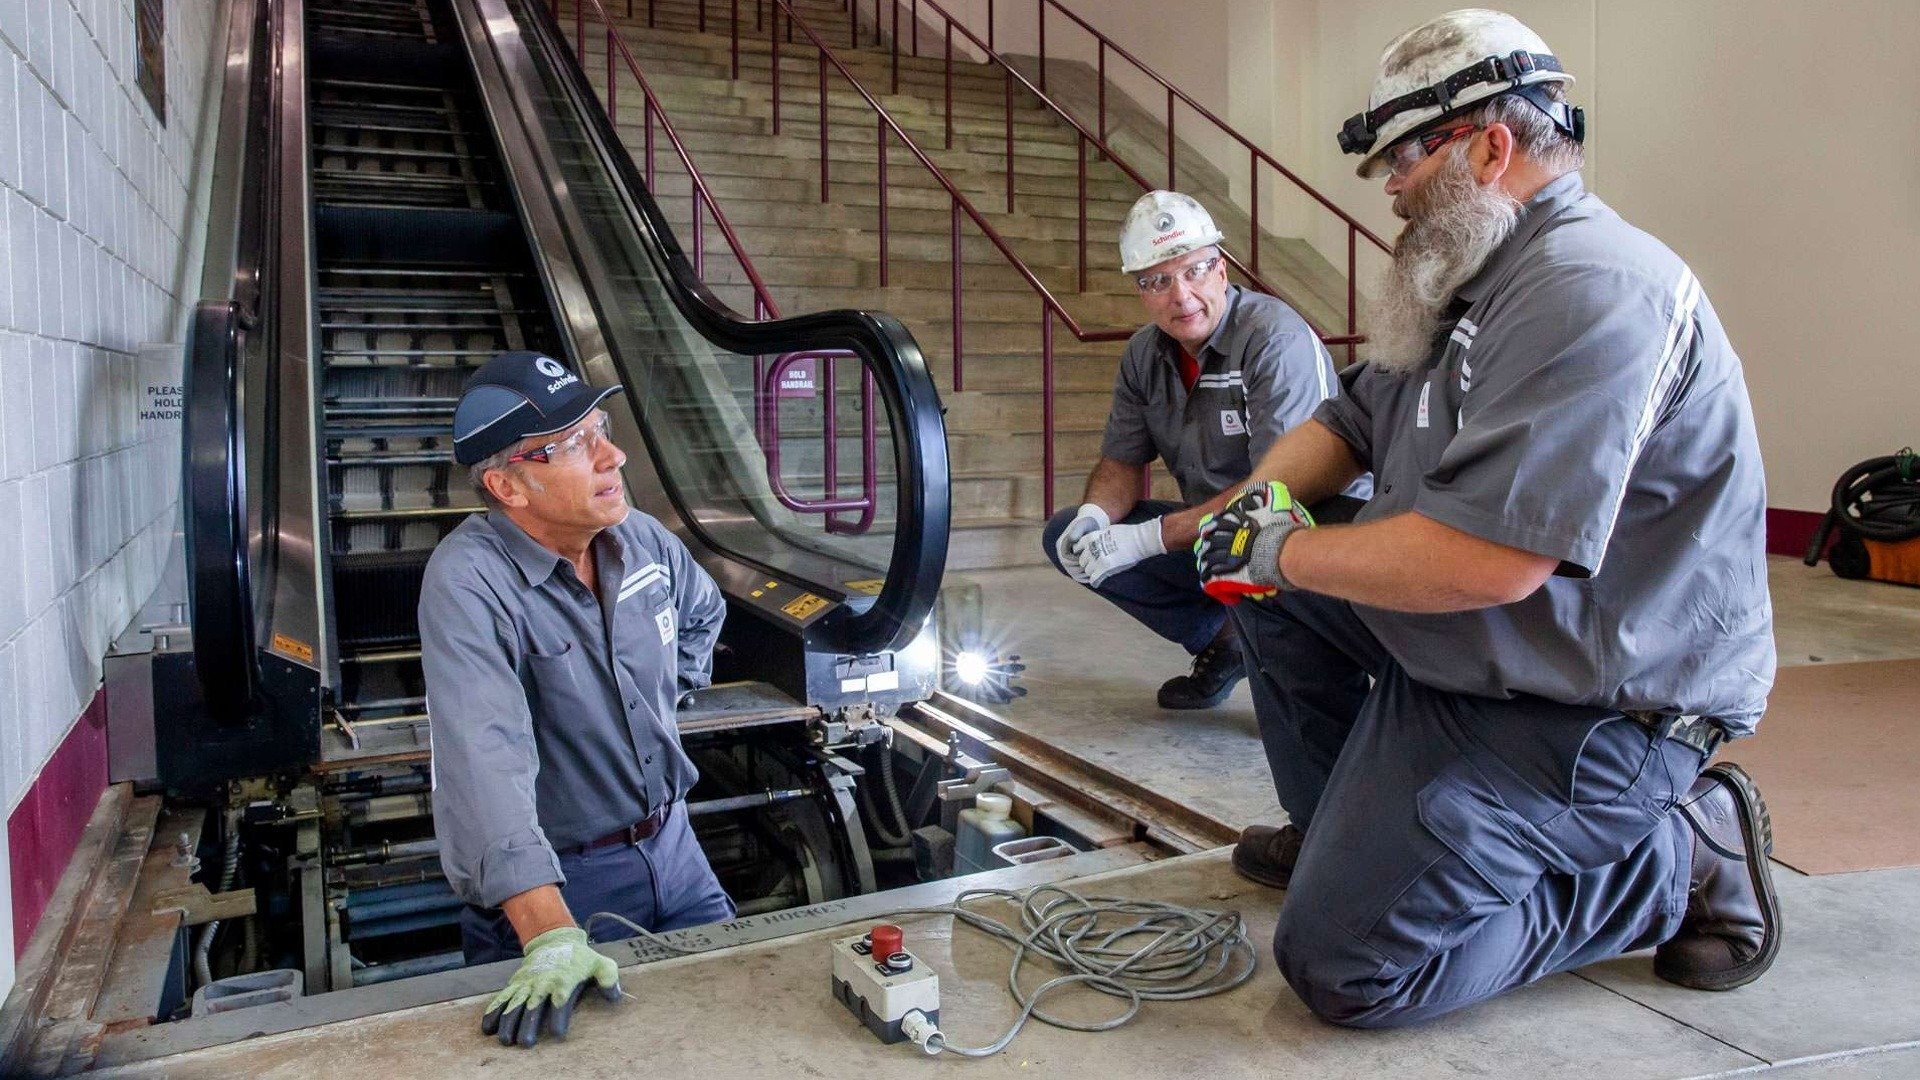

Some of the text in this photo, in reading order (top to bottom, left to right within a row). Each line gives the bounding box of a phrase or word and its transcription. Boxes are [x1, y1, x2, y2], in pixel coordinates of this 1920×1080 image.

[1151, 230, 1186, 247] Schindler
[788, 370, 806, 379] HOLD
[147, 386, 183, 396] PLEAS
[140, 410, 182, 420] HANDR
[762, 902, 847, 925] HOCKEY
